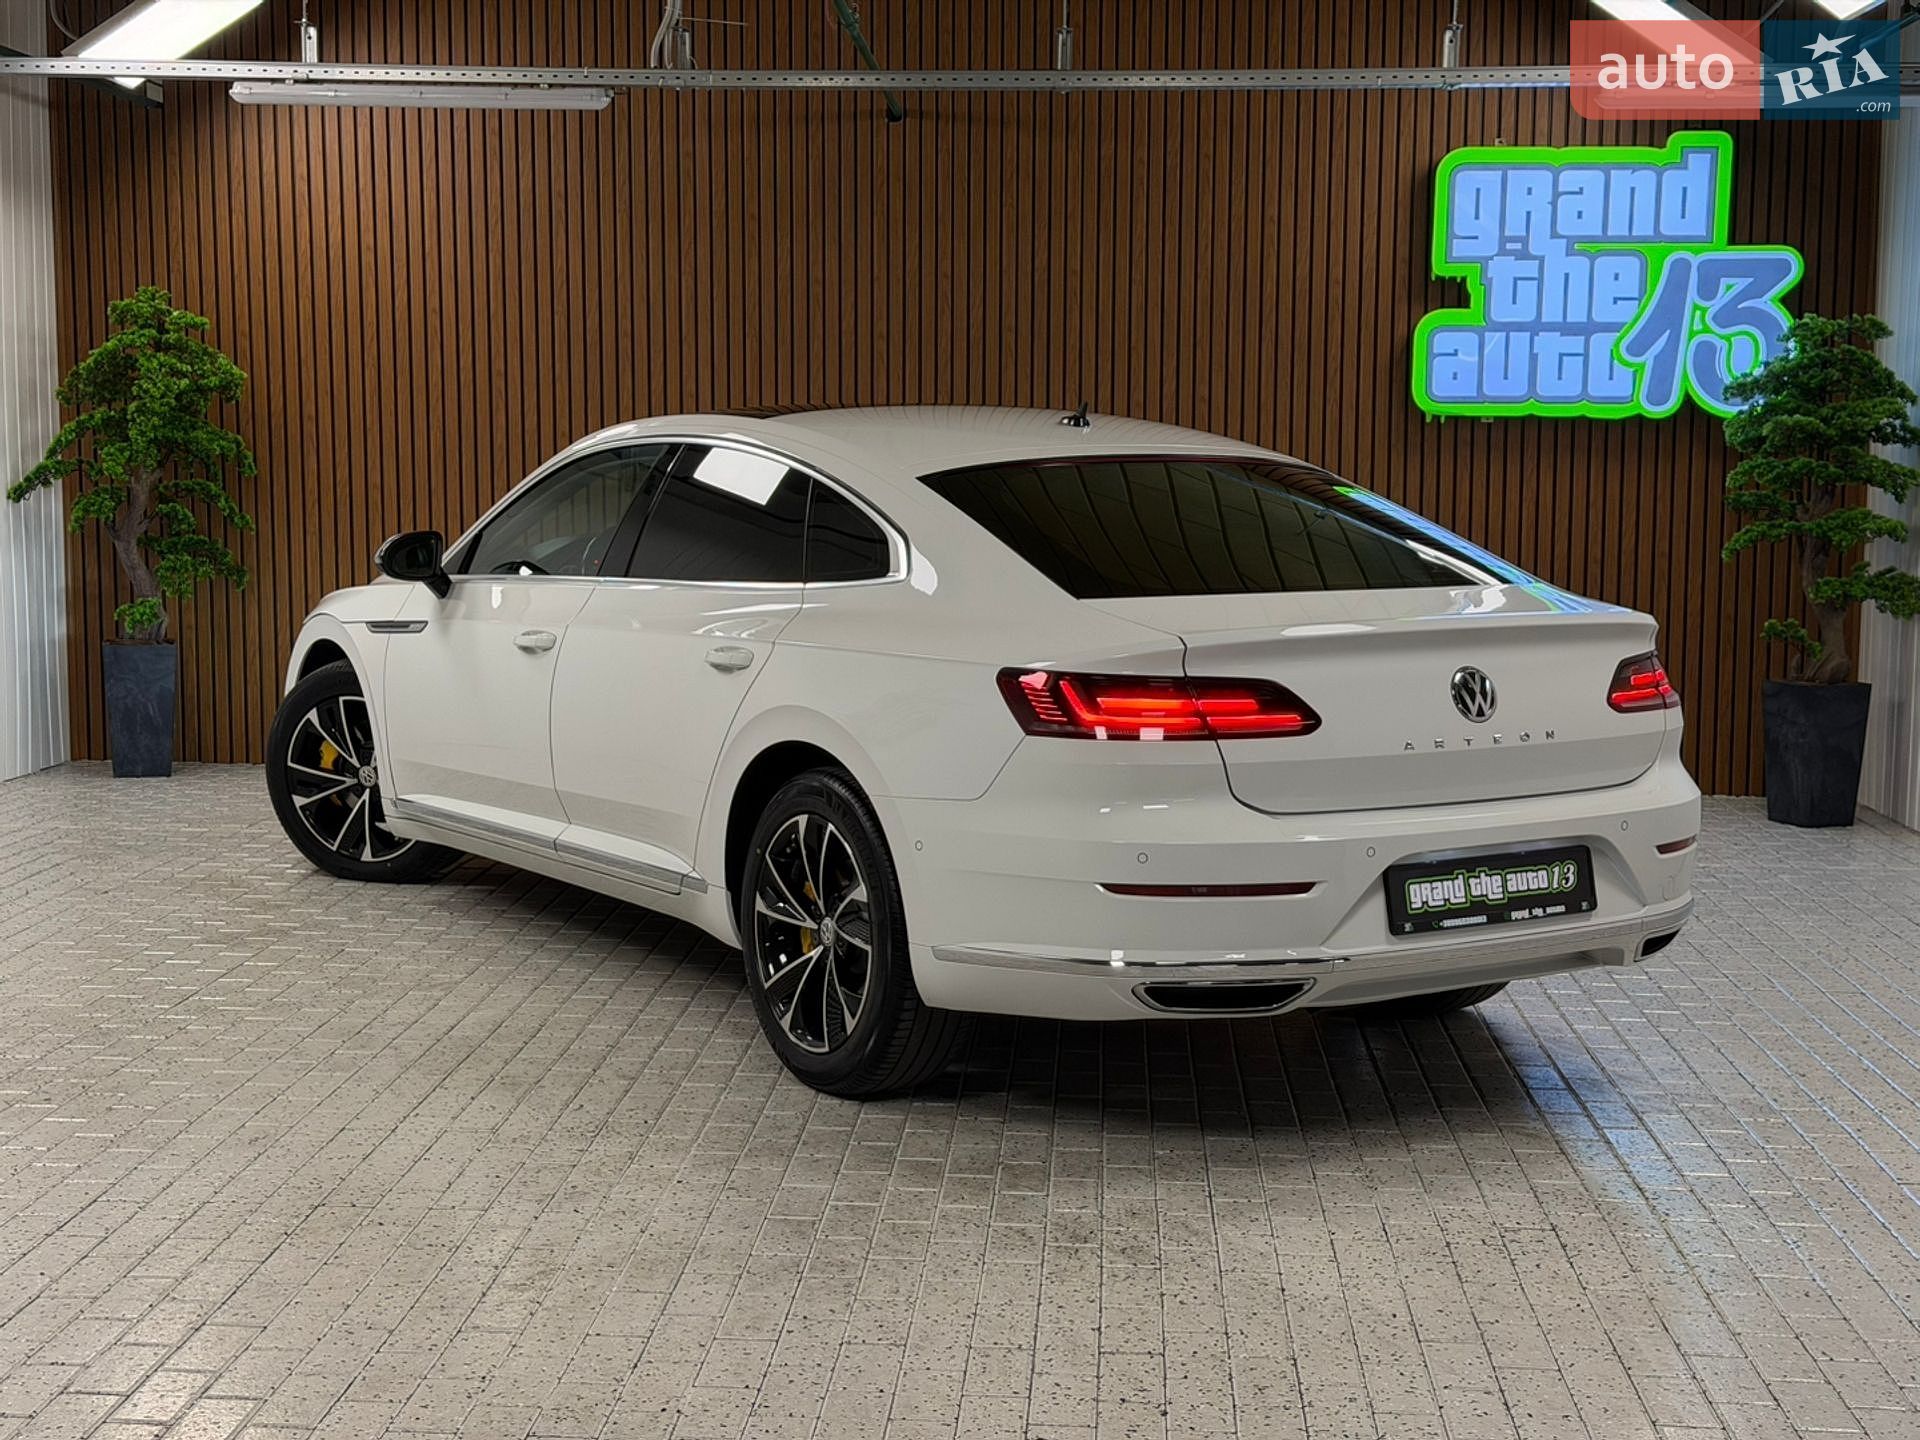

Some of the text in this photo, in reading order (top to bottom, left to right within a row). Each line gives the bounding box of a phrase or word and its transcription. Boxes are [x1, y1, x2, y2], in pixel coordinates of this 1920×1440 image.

[1488, 243, 1642, 322] the
[1620, 251, 1799, 412] 13
[1404, 730, 1555, 751] ARTEON
[1469, 872, 1504, 900] the
[1506, 869, 1549, 892] auto
[1551, 863, 1576, 889] 13
